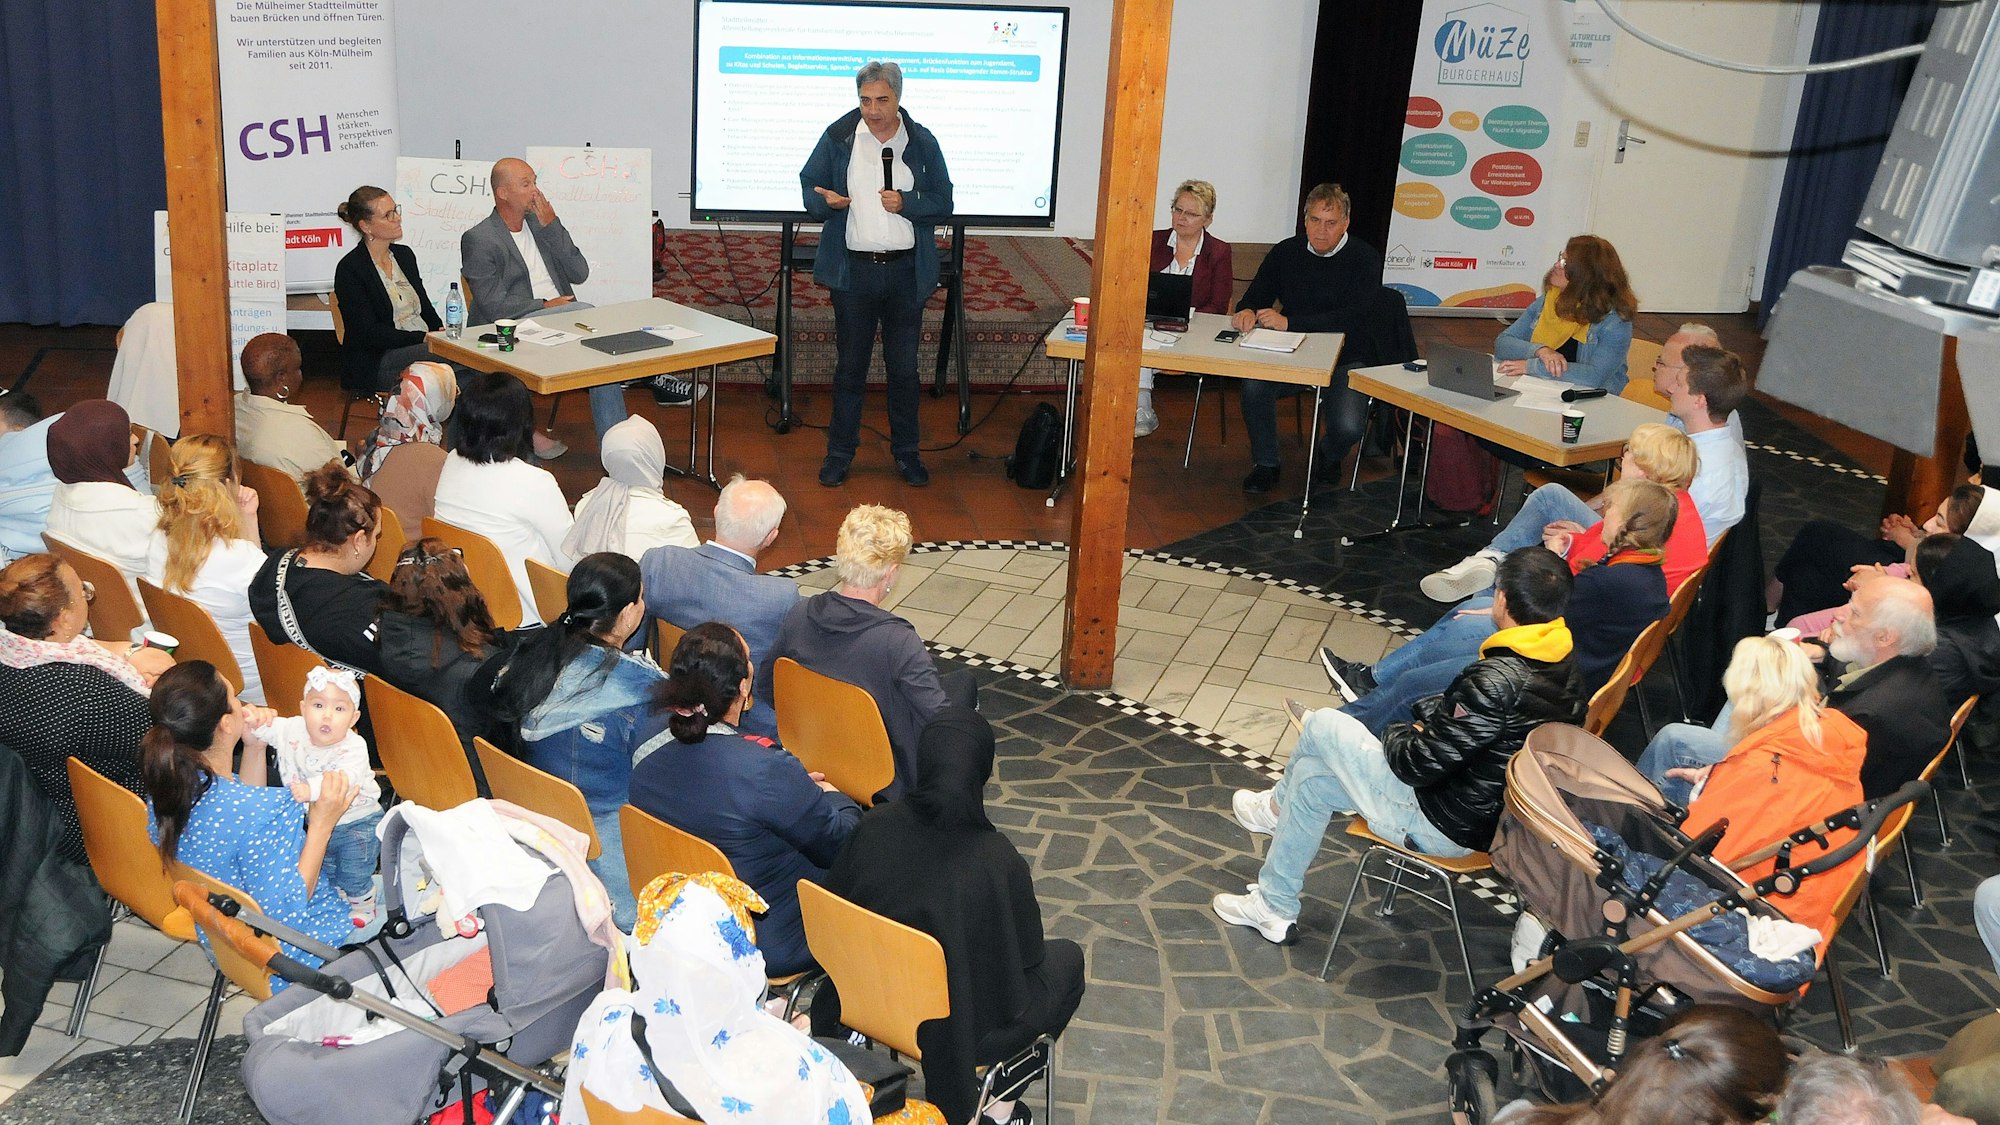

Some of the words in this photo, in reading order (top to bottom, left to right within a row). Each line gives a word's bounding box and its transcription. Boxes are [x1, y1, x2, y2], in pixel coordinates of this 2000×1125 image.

[236, 2, 252, 10] Die
[255, 1, 305, 10] Mülheimer
[308, 1, 378, 10] Stadtteilmütter
[230, 14, 260, 22] bauen
[262, 14, 300, 22] Brücken
[302, 14, 320, 22] und
[323, 13, 354, 22] öffnen
[357, 12, 384, 22] Türen.
[236, 38, 252, 47] Wir
[256, 38, 316, 46] unterstützen
[318, 38, 336, 46] und
[339, 37, 382, 48] begleiten
[1435, 20, 1530, 62] MüZe
[248, 50, 286, 58] Familien
[308, 49, 372, 58] Köln-Mülheim
[289, 62, 306, 70] seit
[308, 62, 332, 70] 2011.
[336, 109, 380, 120] Menschen
[338, 120, 372, 130] stärken.
[239, 114, 332, 161] CSH
[338, 128, 393, 142] Perspektiven
[340, 140, 379, 151] schaffen.
[430, 173, 490, 196] CSH.
[256, 222, 278, 233] bei:
[286, 235, 300, 244] adt
[302, 234, 321, 244] Köln
[256, 280, 280, 290] Bird)
[232, 324, 269, 334] ildungs-
